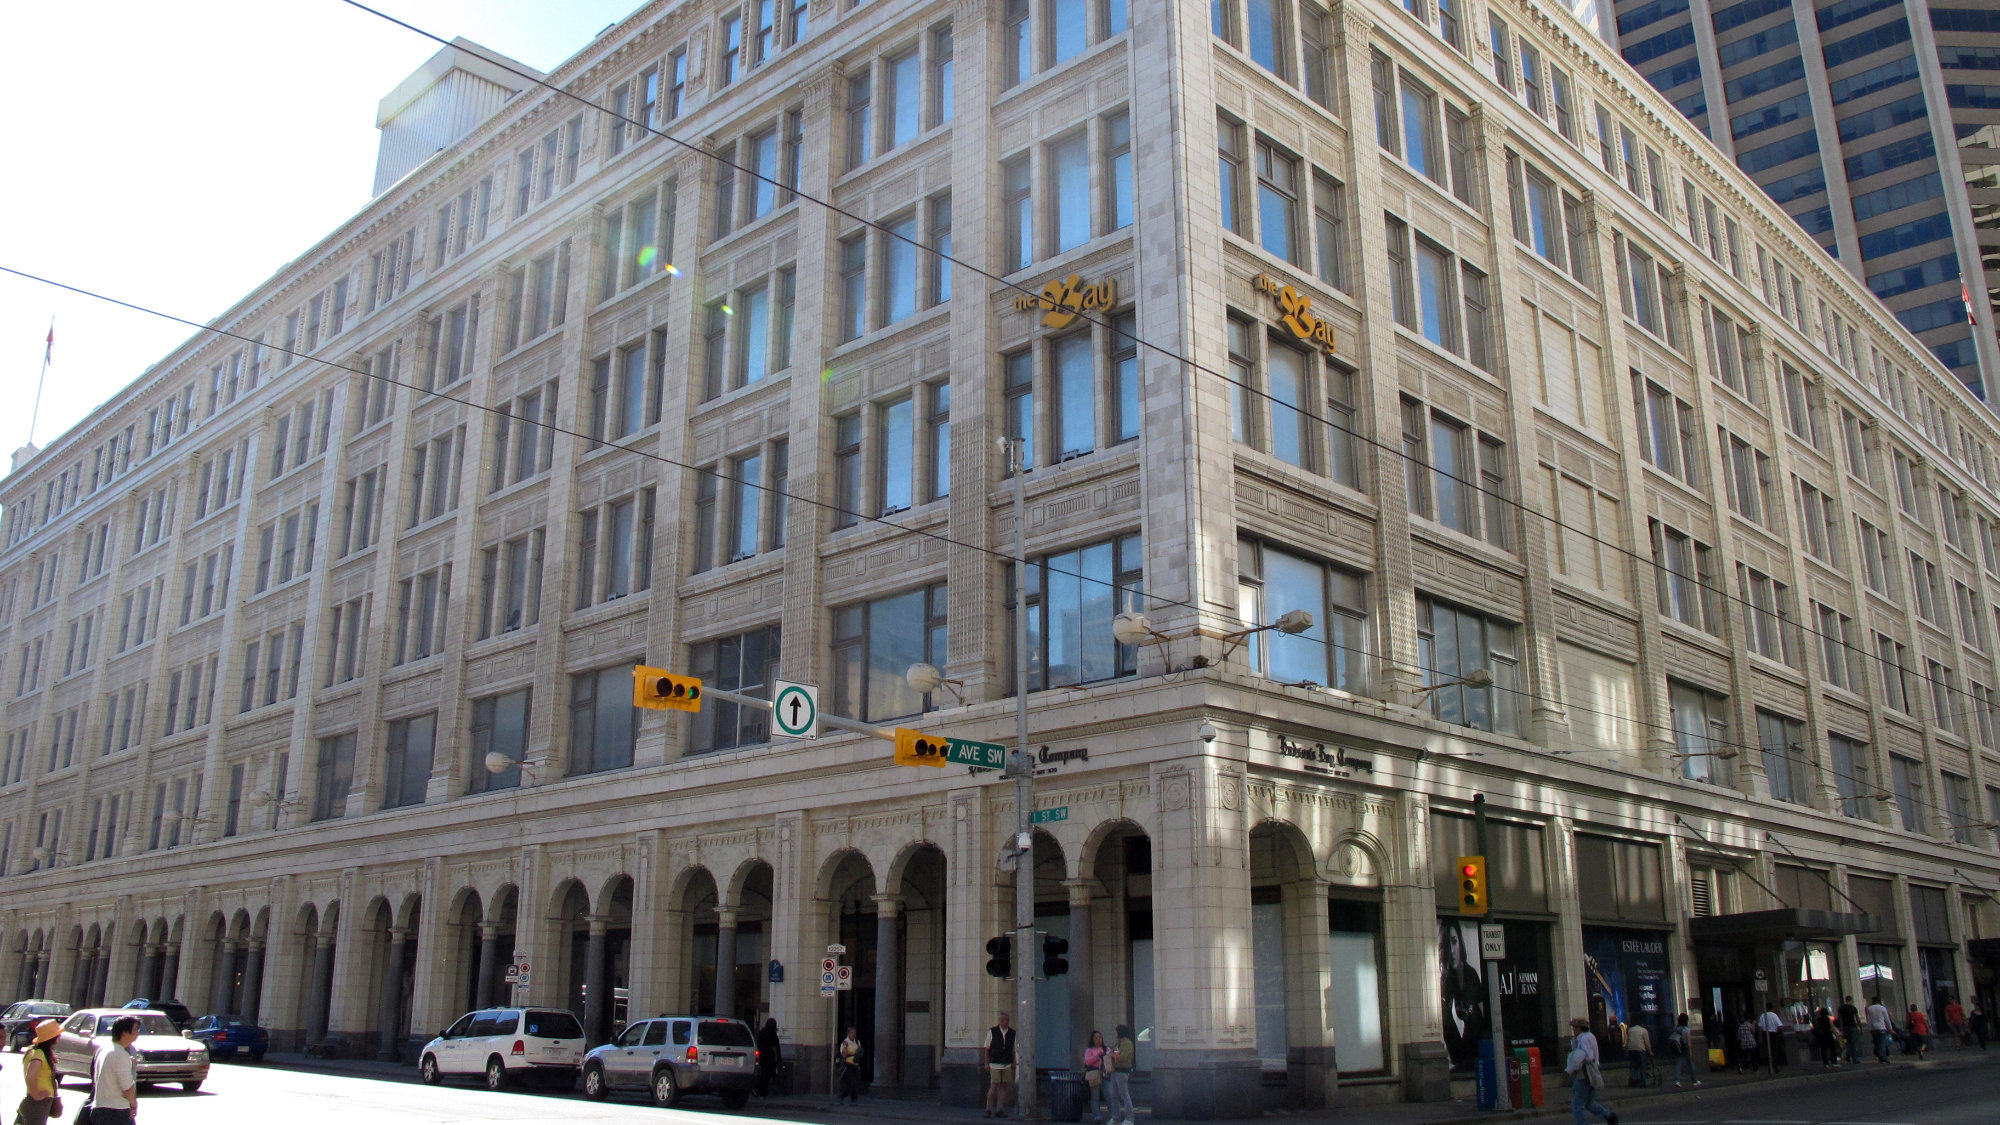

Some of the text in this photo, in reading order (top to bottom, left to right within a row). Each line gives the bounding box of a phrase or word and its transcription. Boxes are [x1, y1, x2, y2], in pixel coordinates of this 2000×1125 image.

[1013, 273, 1116, 329] the Bay
[1257, 272, 1337, 353] the Bay
[946, 743, 954, 757] 7
[959, 744, 980, 761] AVE
[987, 748, 1003, 764] SW
[1039, 744, 1088, 766] Company
[1337, 747, 1373, 774] Company
[1042, 811, 1050, 821] ST
[1056, 809, 1066, 820] SW
[1483, 930, 1501, 939] TRANSIT
[1485, 943, 1501, 952] ONLY
[1499, 972, 1513, 995] AJ
